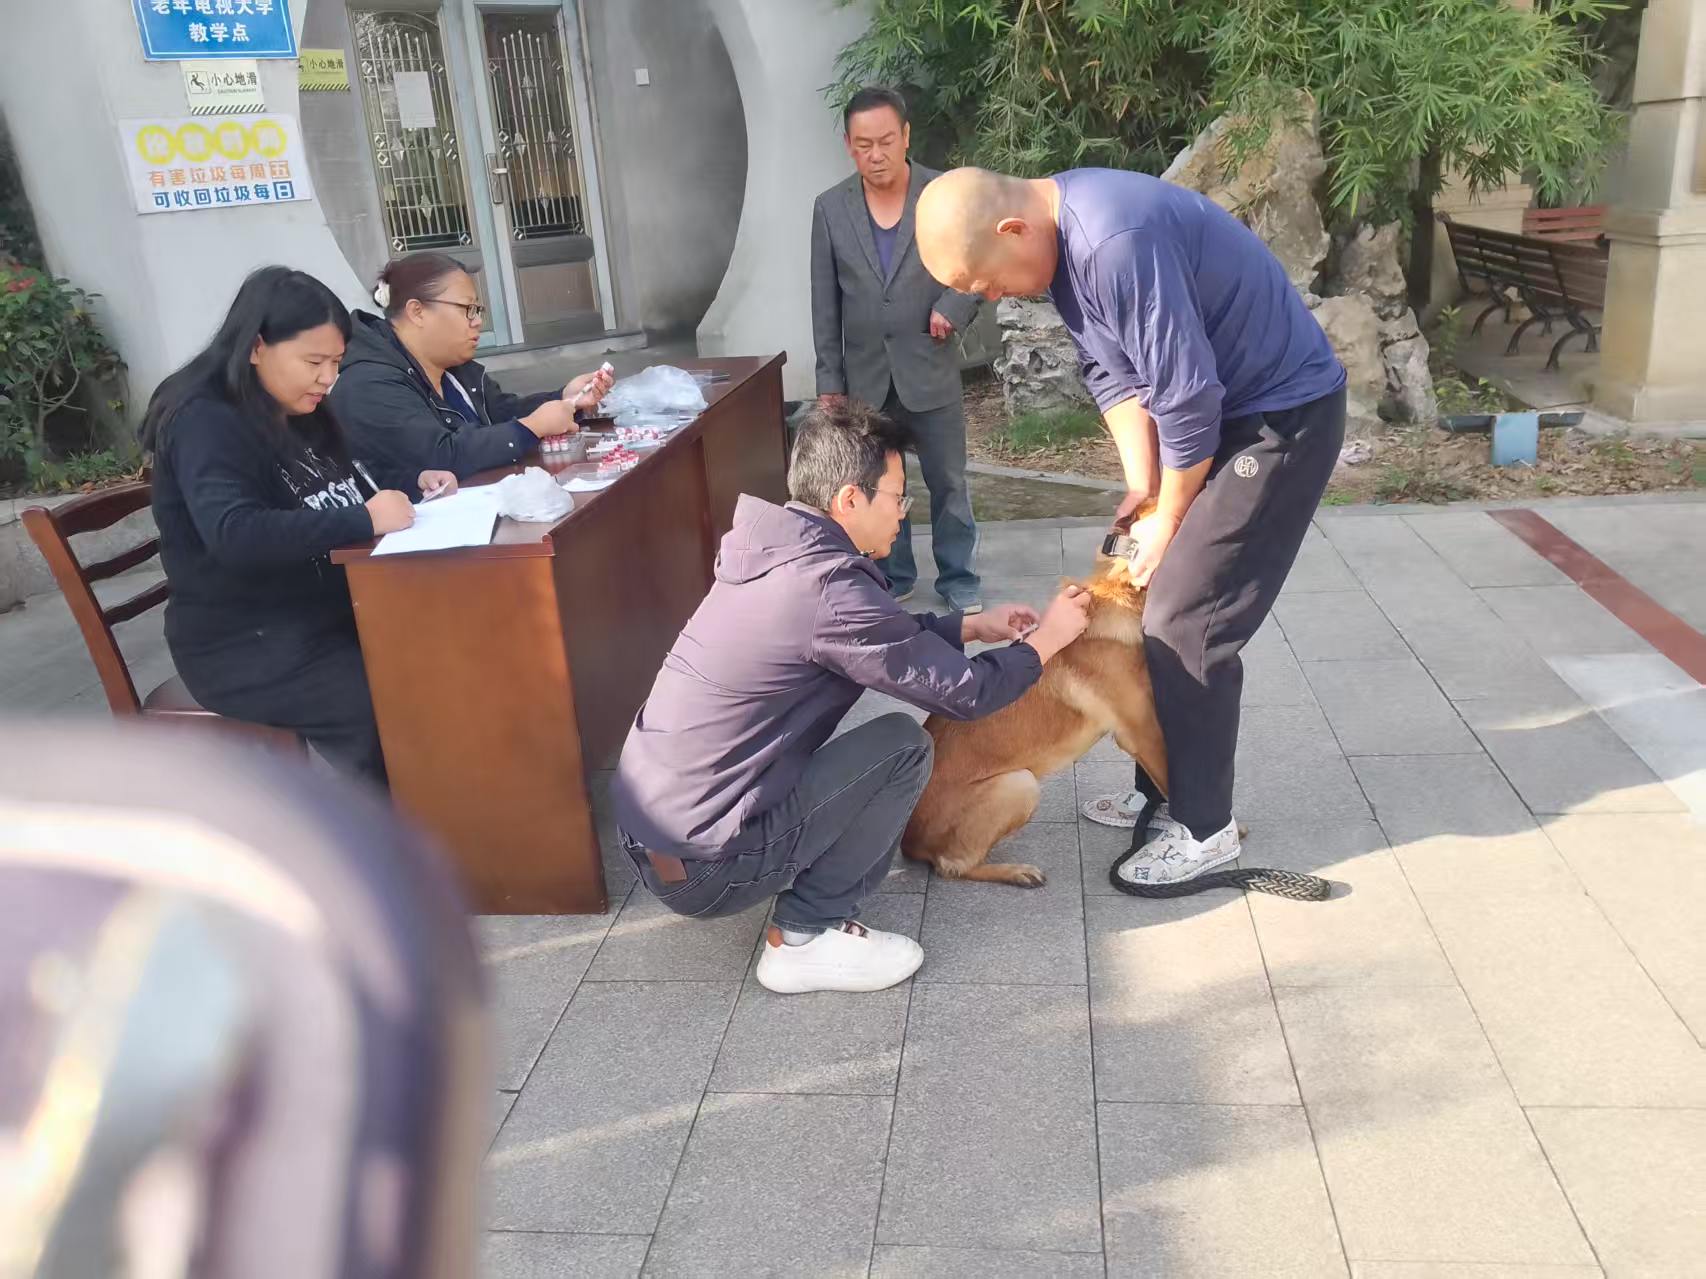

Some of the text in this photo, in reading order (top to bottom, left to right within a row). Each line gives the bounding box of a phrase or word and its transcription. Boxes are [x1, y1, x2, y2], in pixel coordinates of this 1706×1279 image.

[151, 0, 274, 15] 老年电视大学
[188, 22, 250, 42] 教学点
[309, 58, 344, 70] 小心地滑
[211, 71, 256, 87] 小心地滑
[147, 160, 291, 187] 有害垃圾每周五
[151, 180, 294, 206] 可收回垃圾每日
